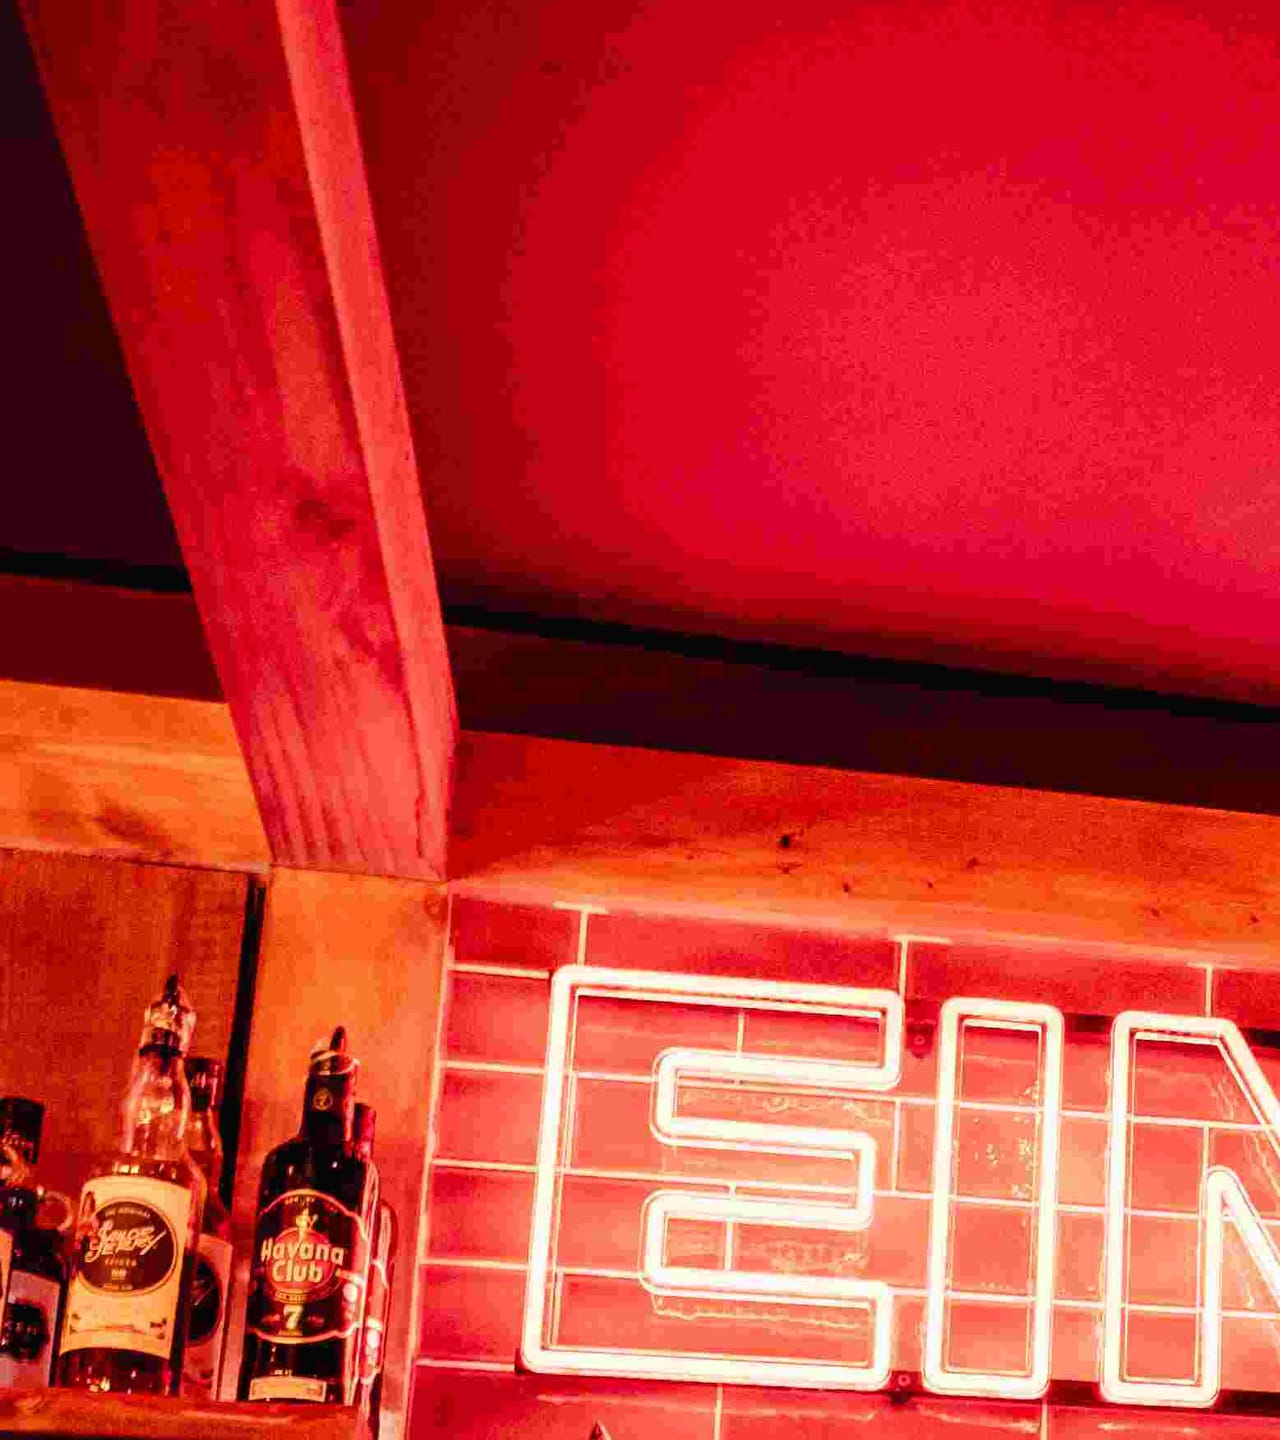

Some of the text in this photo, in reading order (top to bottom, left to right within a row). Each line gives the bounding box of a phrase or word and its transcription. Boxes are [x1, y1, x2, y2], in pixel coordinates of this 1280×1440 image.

[260, 1238, 345, 1266] Havana
[271, 1259, 324, 1282] Club
[283, 1303, 304, 1331] 7
